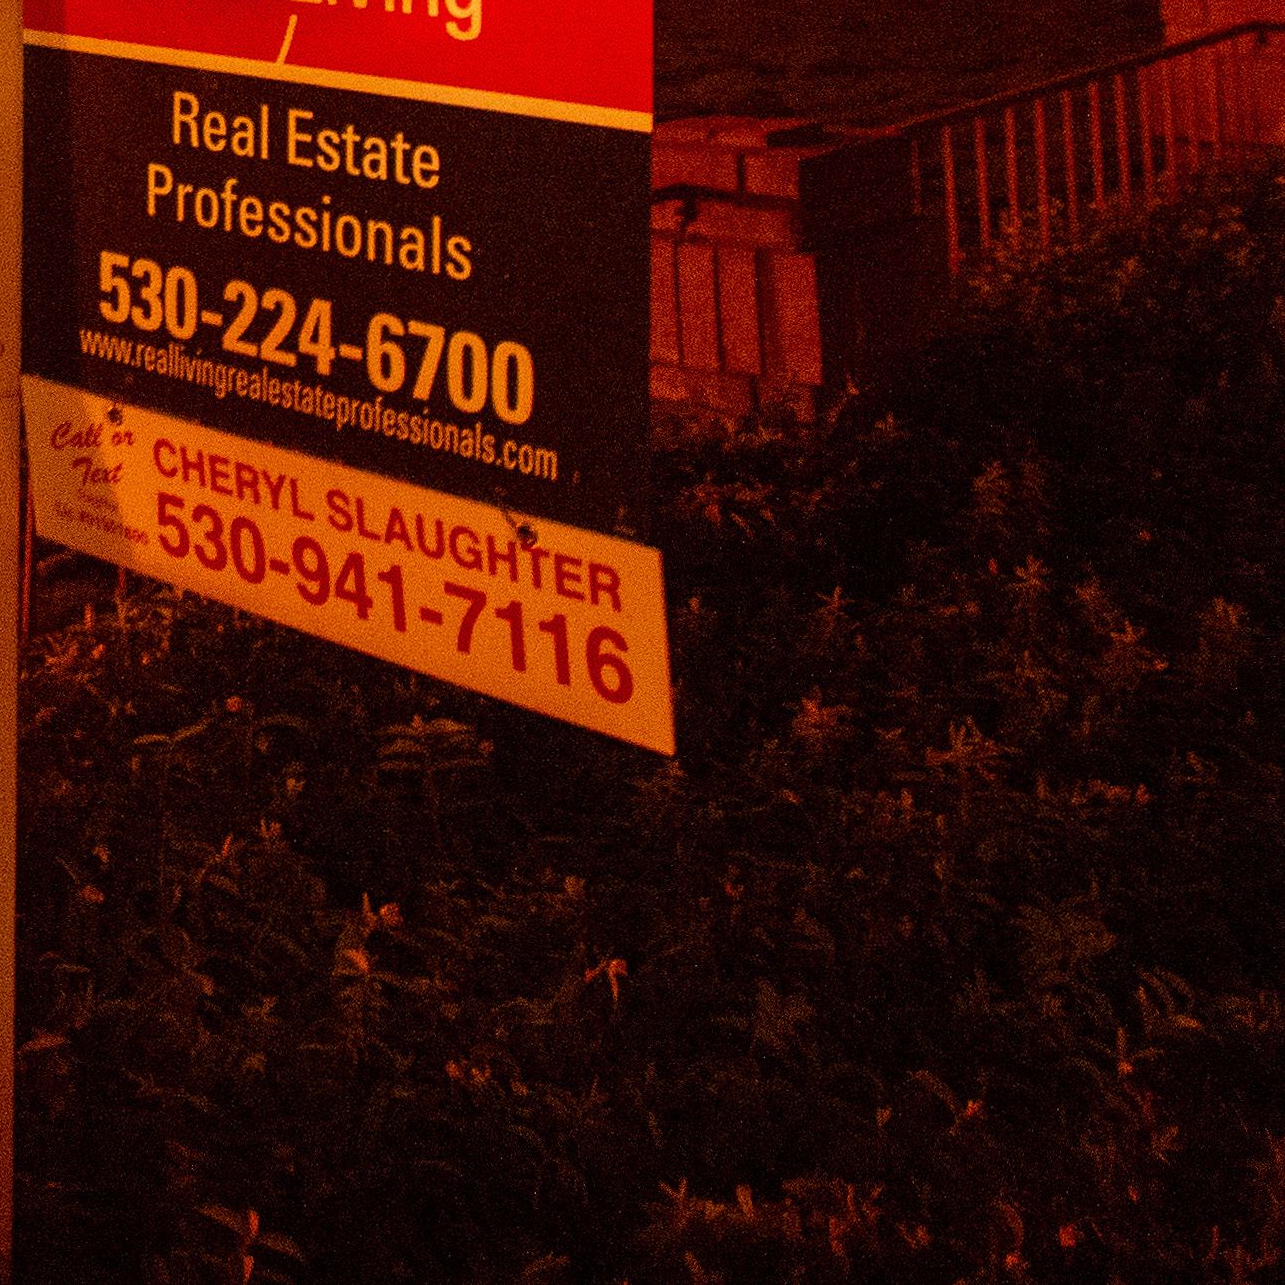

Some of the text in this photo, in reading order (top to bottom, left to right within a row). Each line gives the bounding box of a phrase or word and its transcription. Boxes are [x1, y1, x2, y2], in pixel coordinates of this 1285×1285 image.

[172, 91, 440, 189] Real Estate
[147, 163, 472, 281] Professionals
[80, 327, 558, 481] www.reallivingrealestateprofessionals.com
[99, 250, 535, 425] 530-224-6700
[50, 421, 134, 449] Call or
[72, 456, 122, 486] Text
[153, 438, 622, 612] CHERYL SLAUGHTER
[157, 492, 633, 704] 530-941-7116
